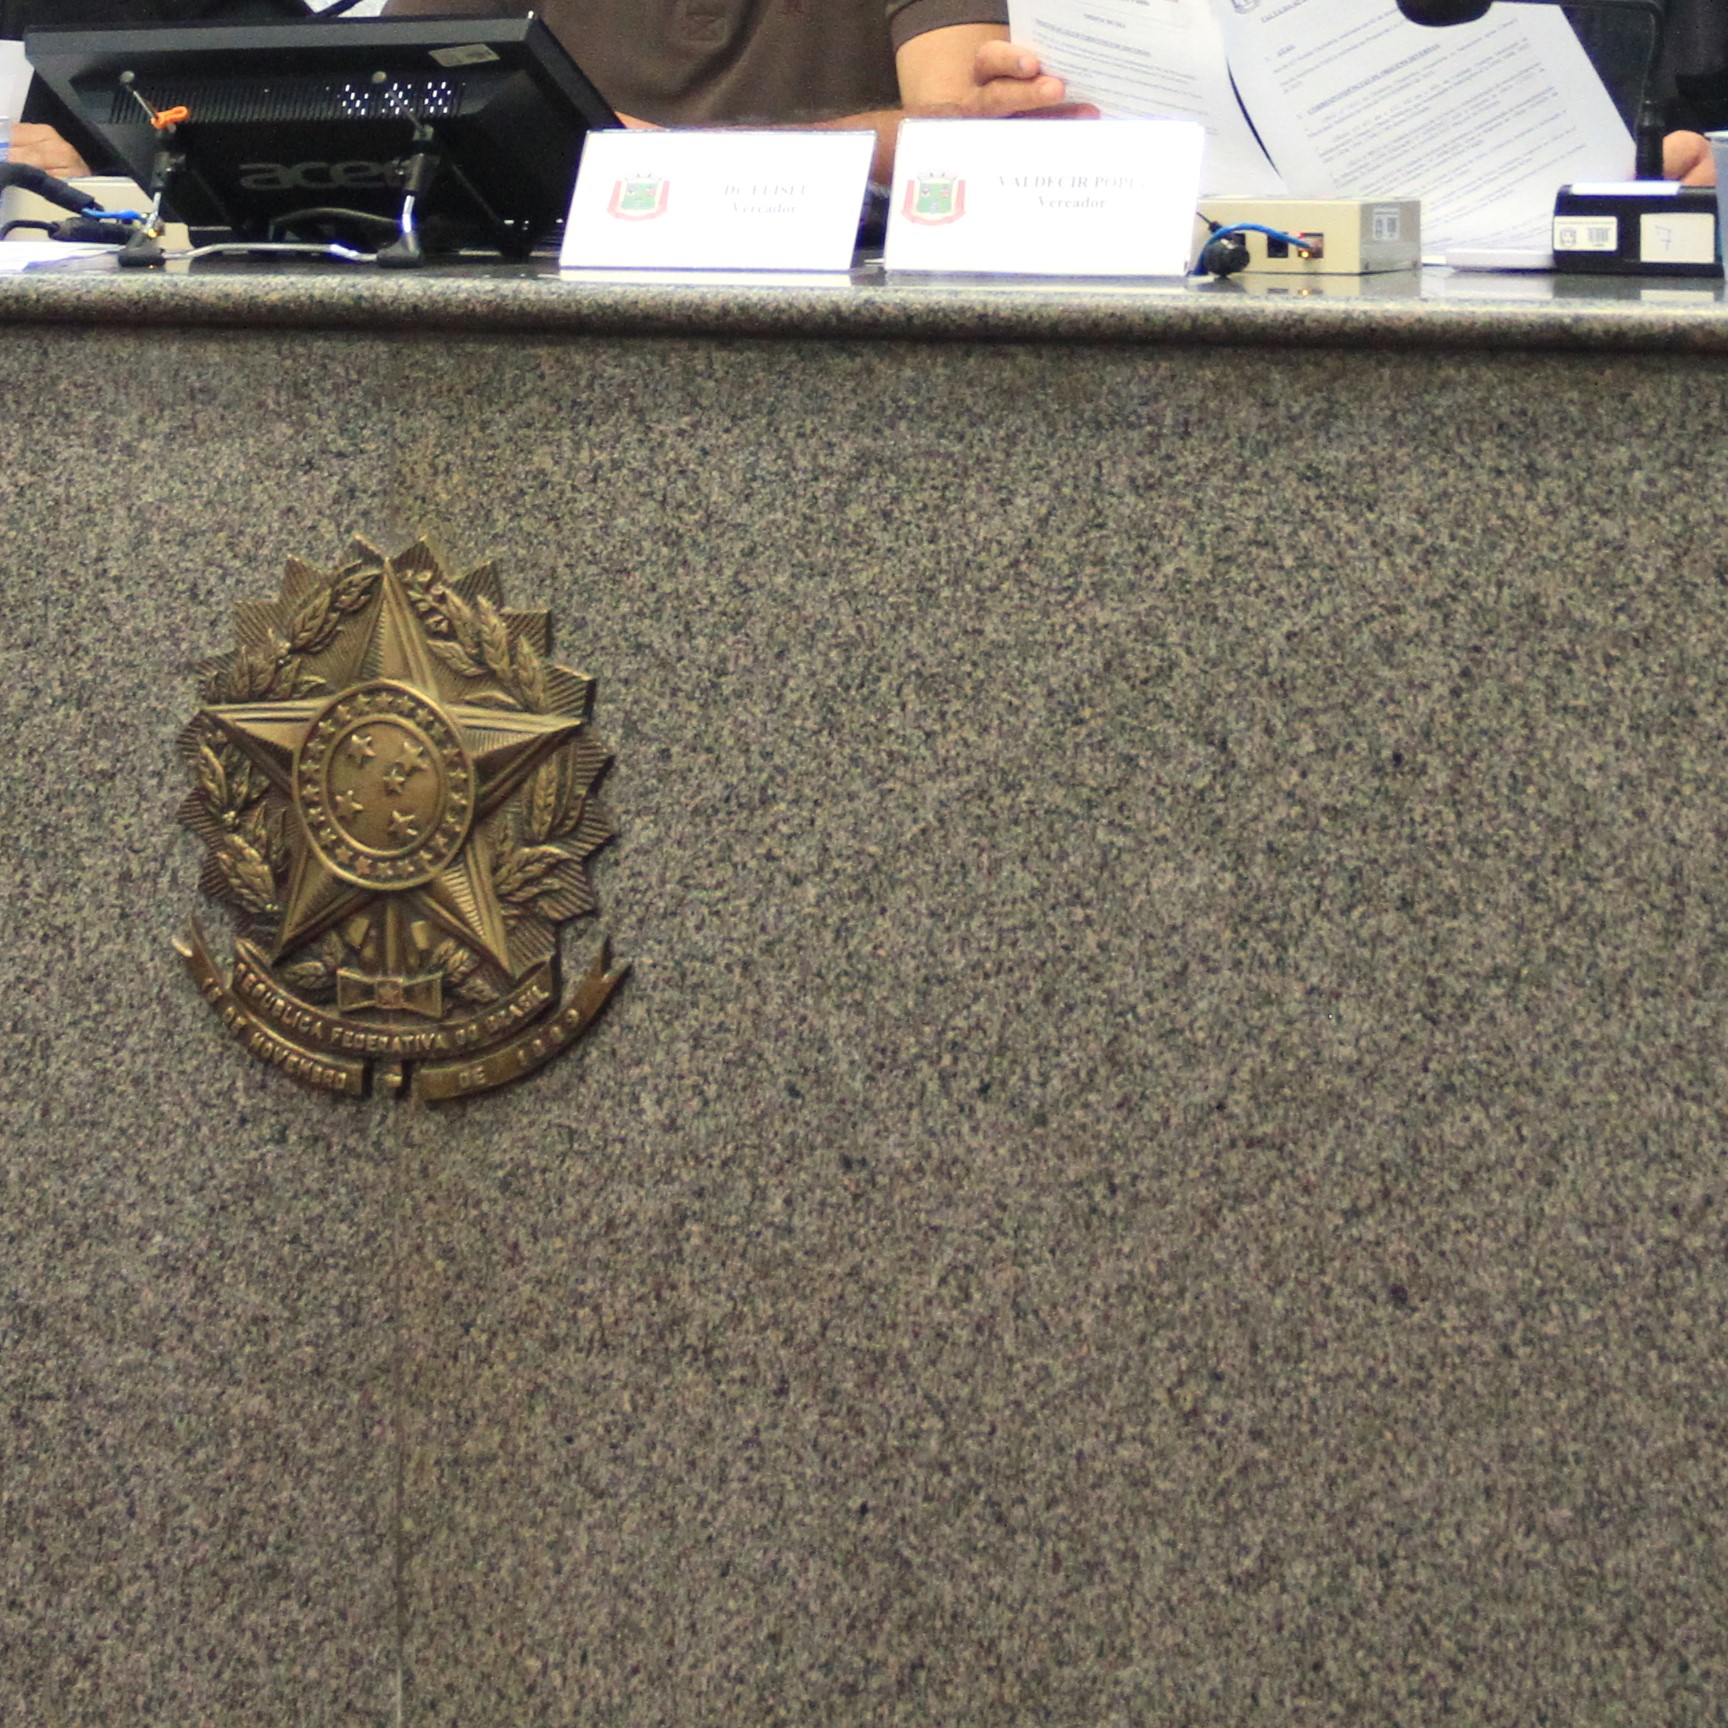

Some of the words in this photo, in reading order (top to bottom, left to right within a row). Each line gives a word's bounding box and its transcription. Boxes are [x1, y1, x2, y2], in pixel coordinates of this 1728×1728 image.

[1038, 195, 1106, 208] Vereador
[330, 1027, 449, 1052] FEDERATIVA
[251, 1030, 347, 1090] NOVEMBRO
